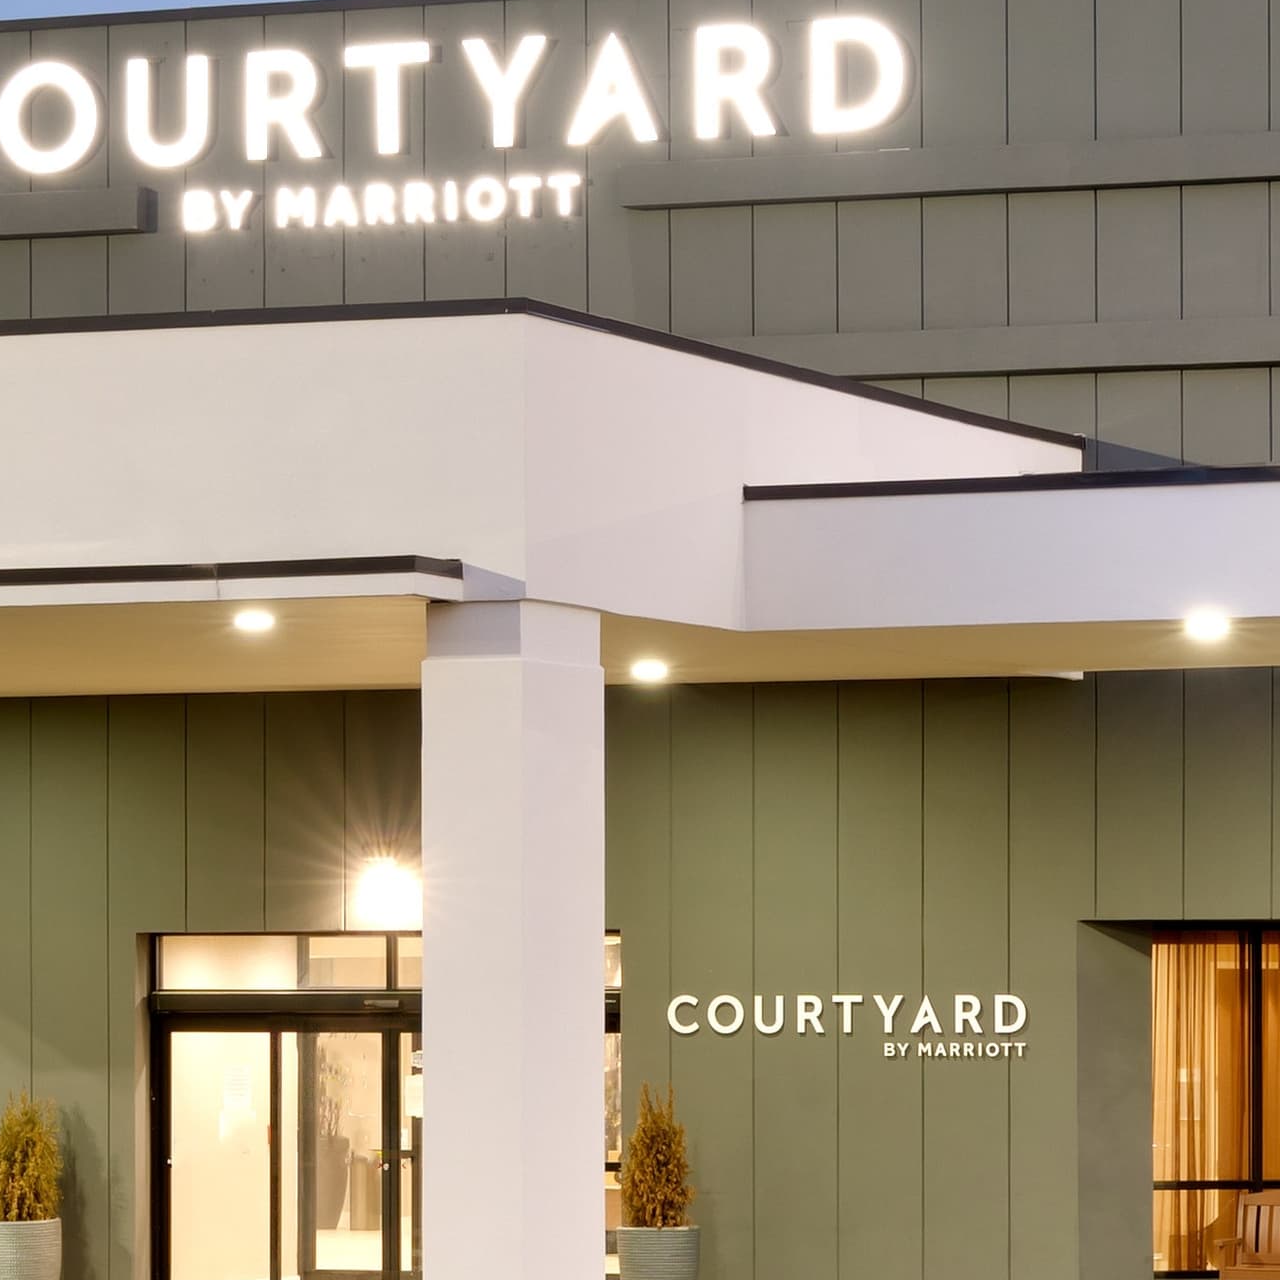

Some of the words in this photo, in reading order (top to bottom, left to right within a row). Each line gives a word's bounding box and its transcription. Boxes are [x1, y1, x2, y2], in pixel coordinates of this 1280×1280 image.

[180, 190, 252, 232] BY
[277, 173, 582, 228] MARRIOTT
[667, 994, 1028, 1035] COURTYARD
[883, 1042, 909, 1057] BY
[918, 1042, 1027, 1058] MARRIOTT
